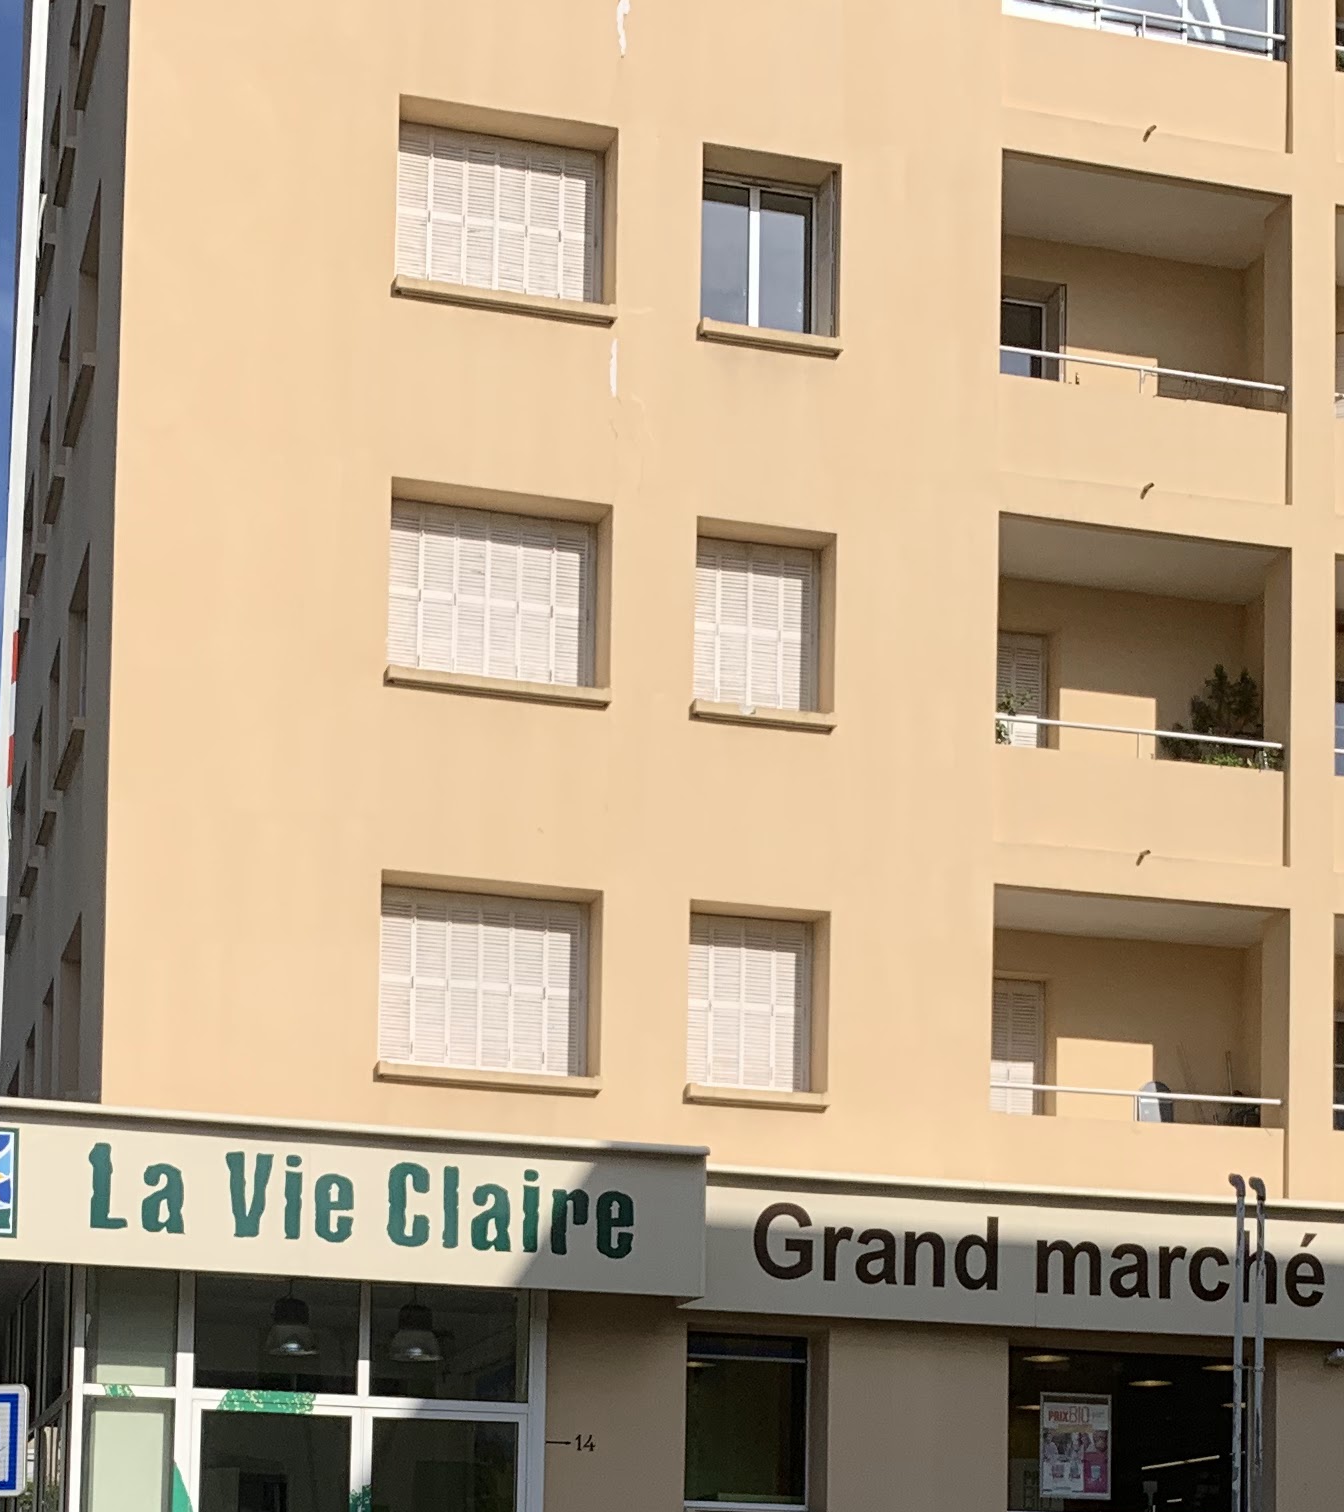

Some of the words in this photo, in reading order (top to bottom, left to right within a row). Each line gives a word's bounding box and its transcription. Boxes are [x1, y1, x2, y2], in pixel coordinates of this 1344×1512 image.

[88, 1142, 186, 1235] La
[225, 1151, 355, 1243] Vie
[386, 1161, 635, 1260] Claire
[753, 1202, 999, 1292] Grand
[1036, 1232, 1326, 1308] marché
[575, 1434, 597, 1452] 14
